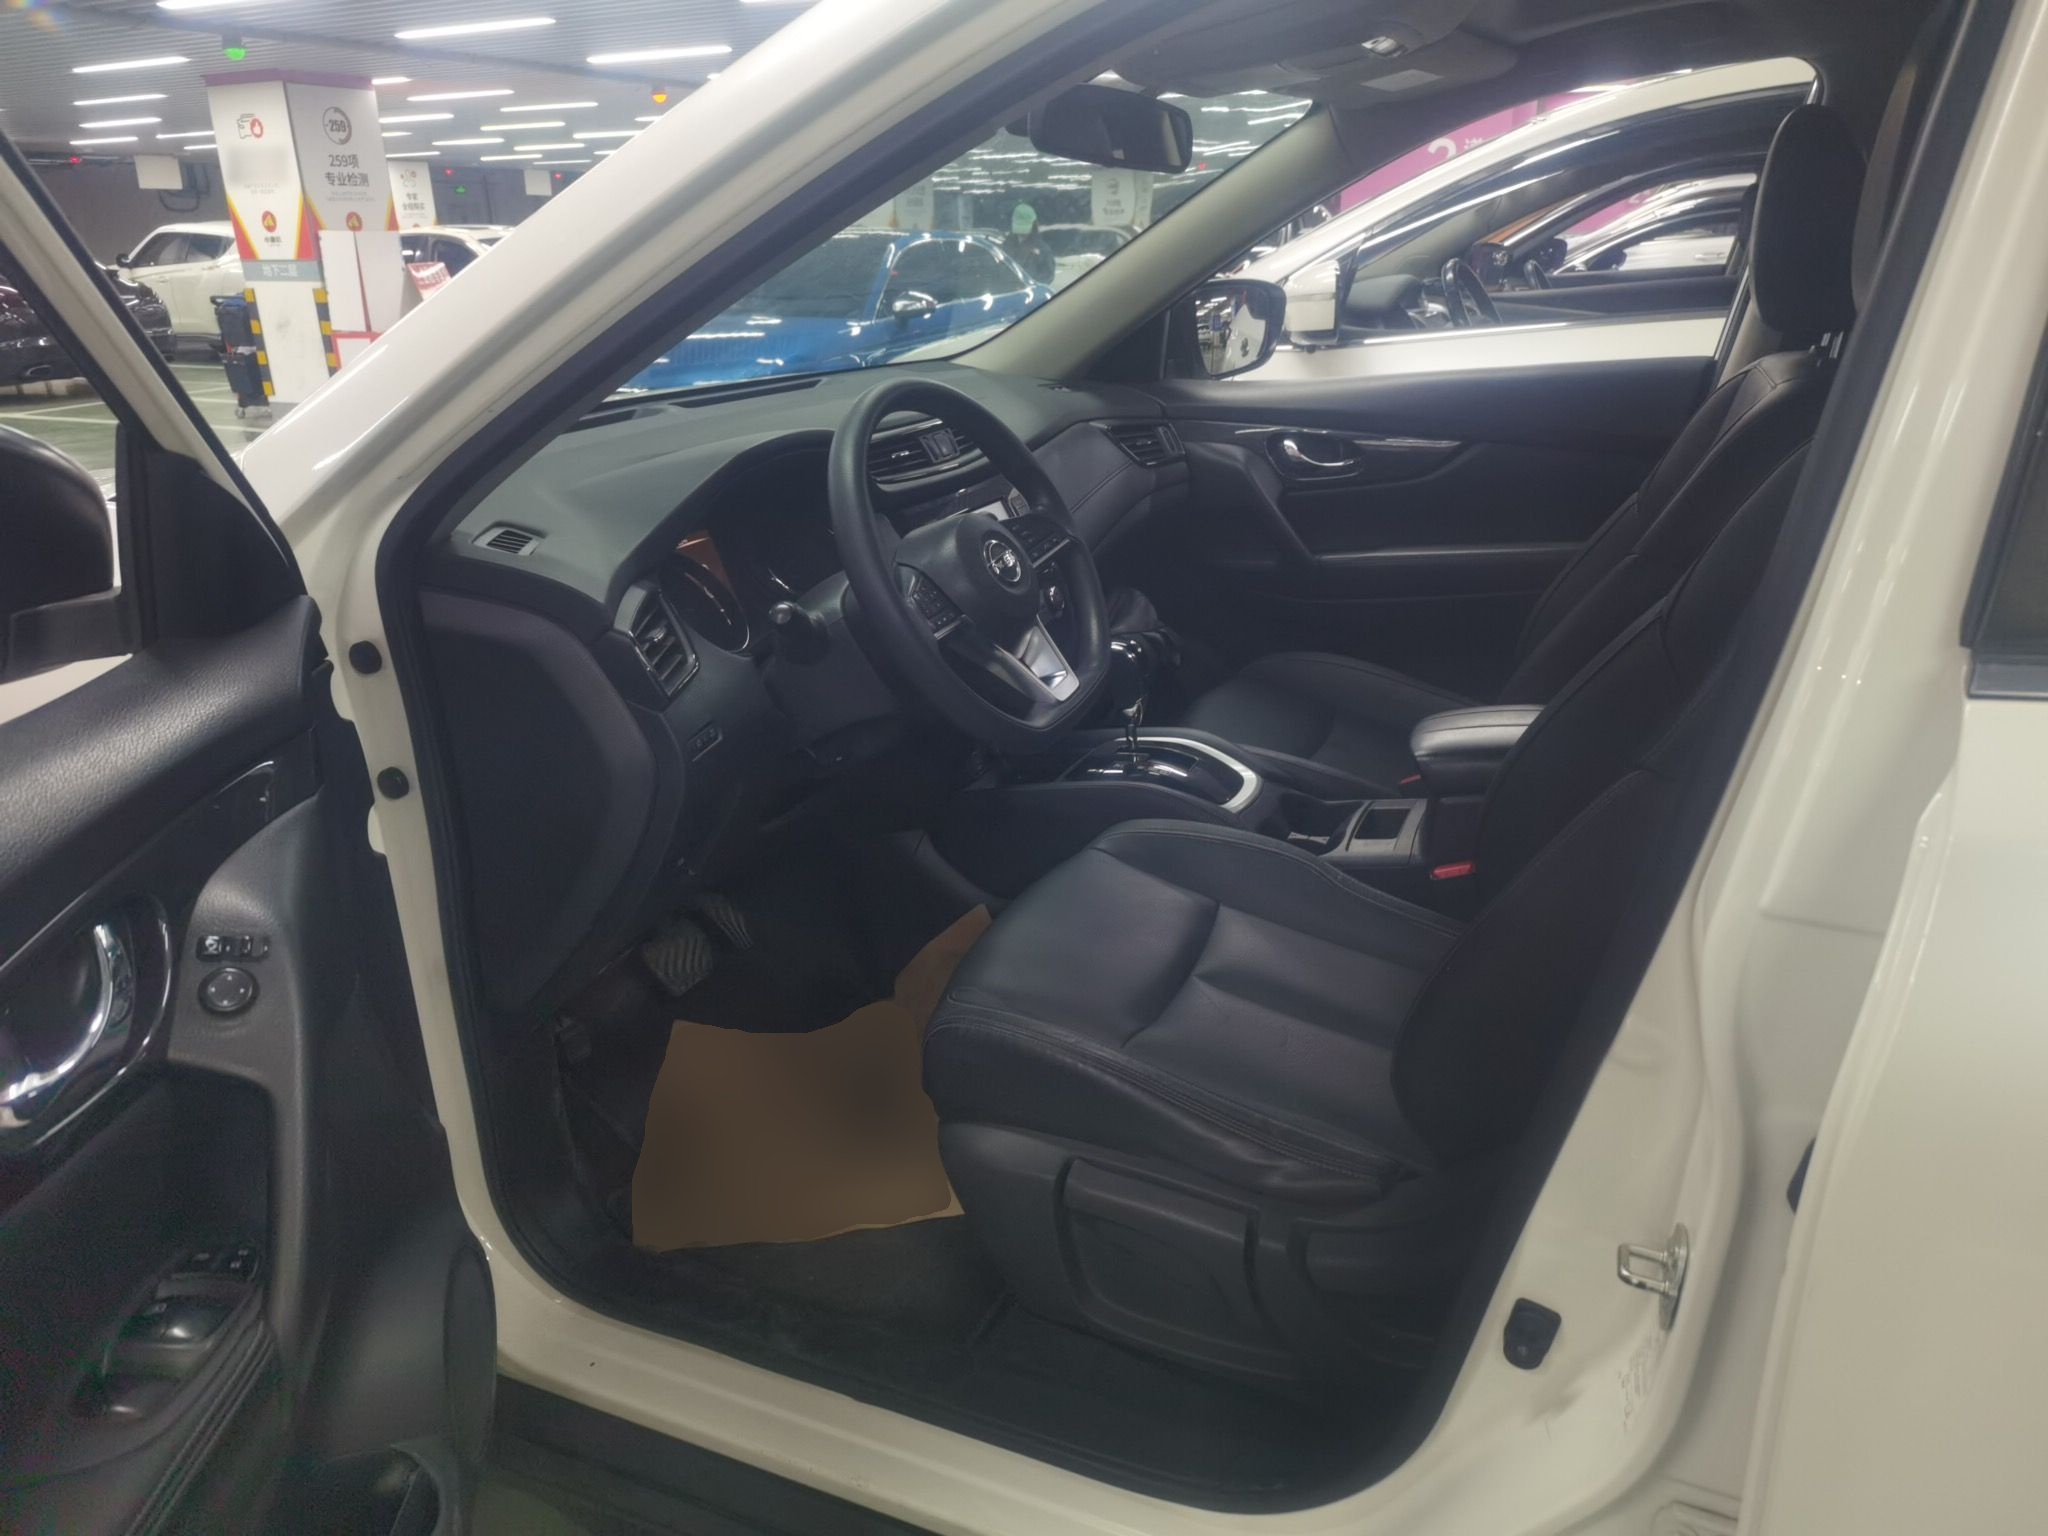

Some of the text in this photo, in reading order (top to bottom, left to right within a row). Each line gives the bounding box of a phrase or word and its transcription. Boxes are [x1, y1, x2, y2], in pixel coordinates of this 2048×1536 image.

[328, 119, 347, 133] 259
[328, 153, 360, 169] 259项
[324, 171, 370, 187] 专业检测
